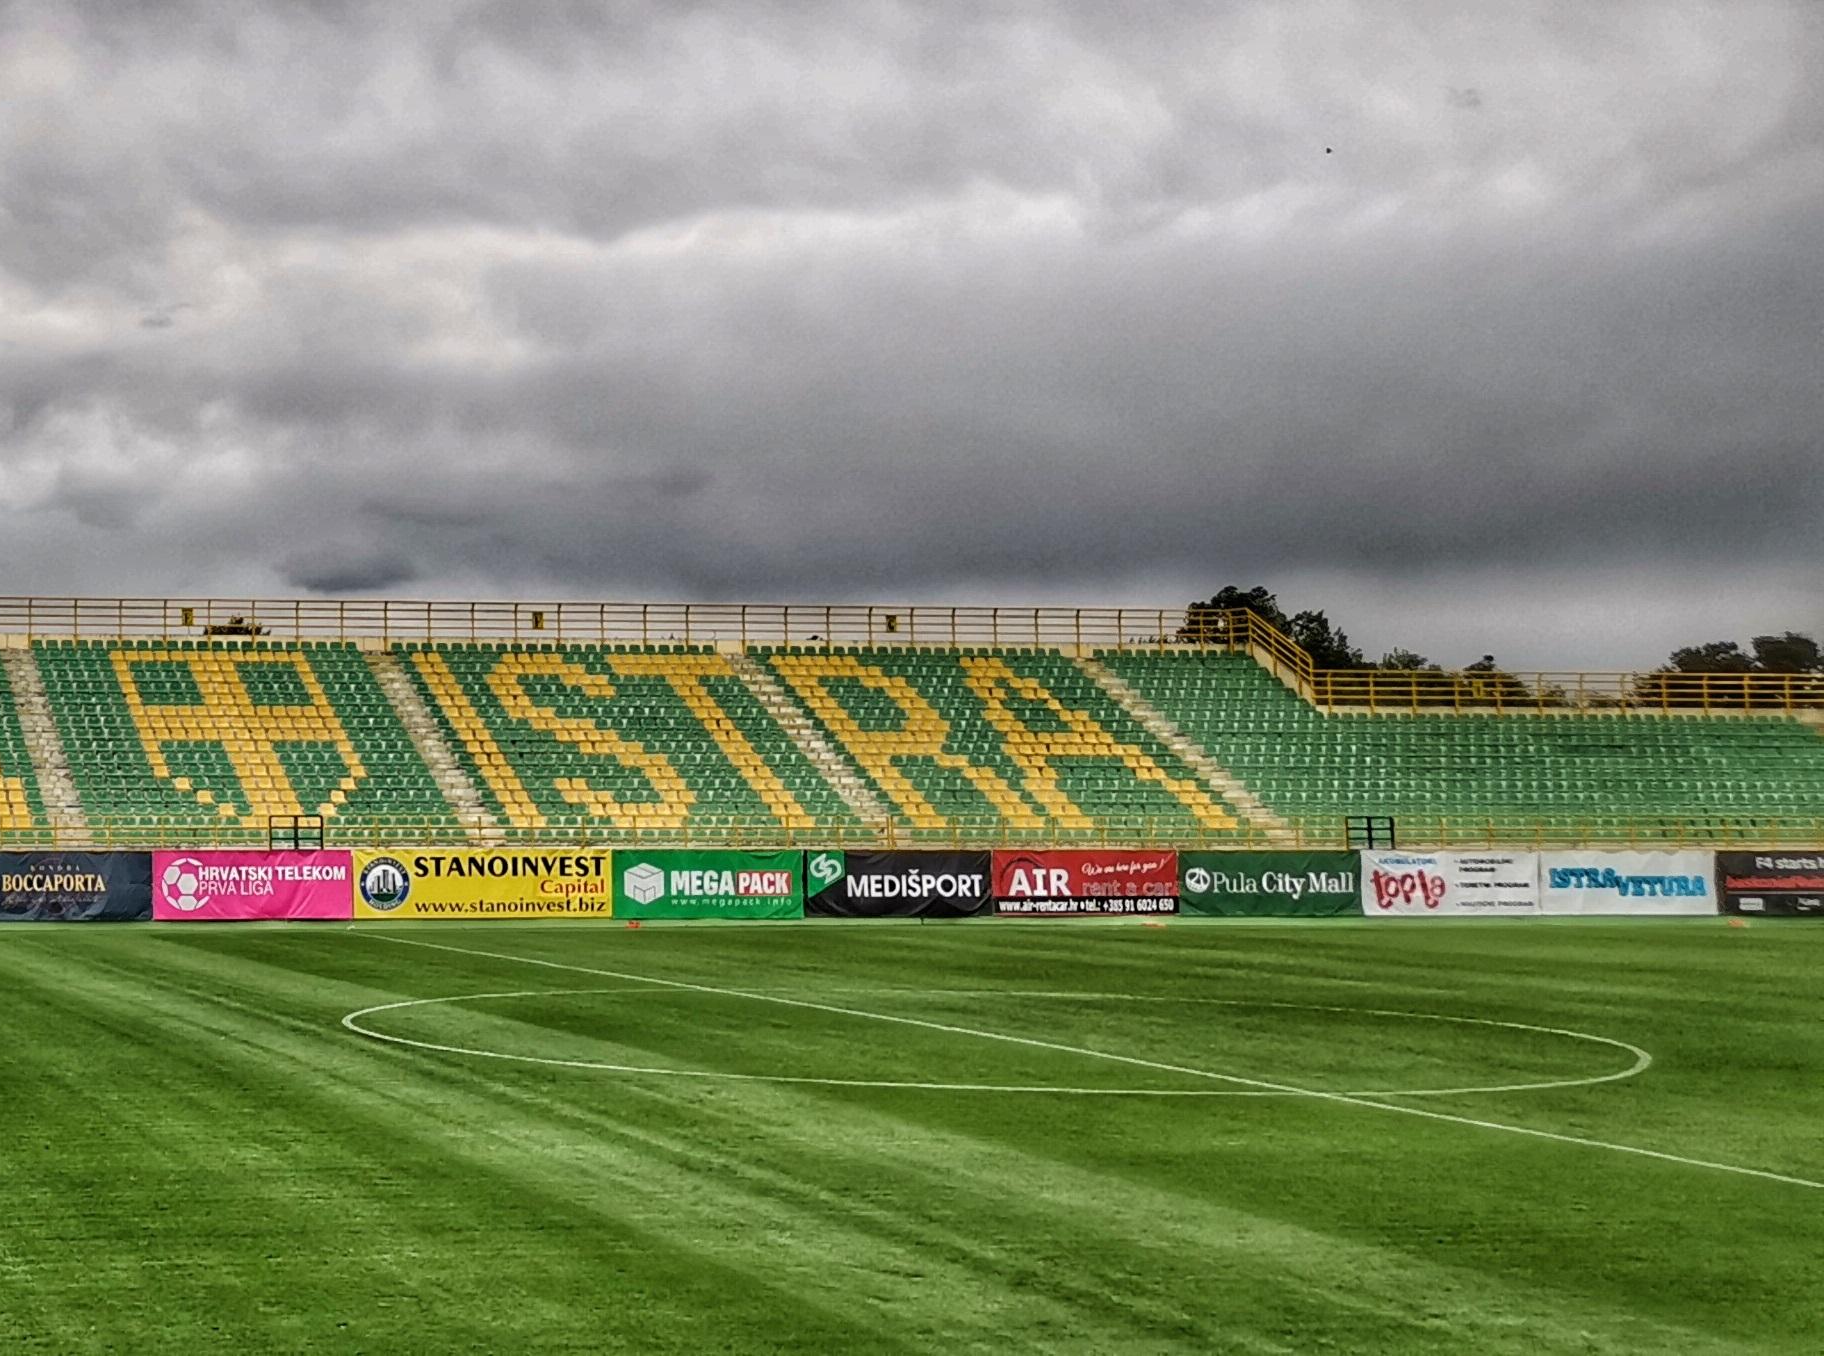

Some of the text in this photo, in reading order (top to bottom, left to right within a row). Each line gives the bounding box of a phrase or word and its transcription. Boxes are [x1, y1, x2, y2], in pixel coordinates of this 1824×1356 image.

[409, 651, 1238, 829] ISTRA
[414, 857, 606, 877] STANOINVEST
[1775, 858, 1817, 869] starts
[198, 865, 346, 881] HRVATSKI TELEKOM
[1, 874, 106, 892] BOCCAPORTA
[199, 880, 274, 896] PRVA LIGA
[540, 879, 605, 897] Capital
[670, 870, 789, 896] MEGA PACK
[846, 869, 983, 898] MEDIŠPORT
[1008, 869, 1072, 896] AIR
[1082, 880, 1172, 896] rent a car
[1212, 872, 1354, 899] Pula City Mall
[415, 897, 606, 913] www.stanoinvest.biz
